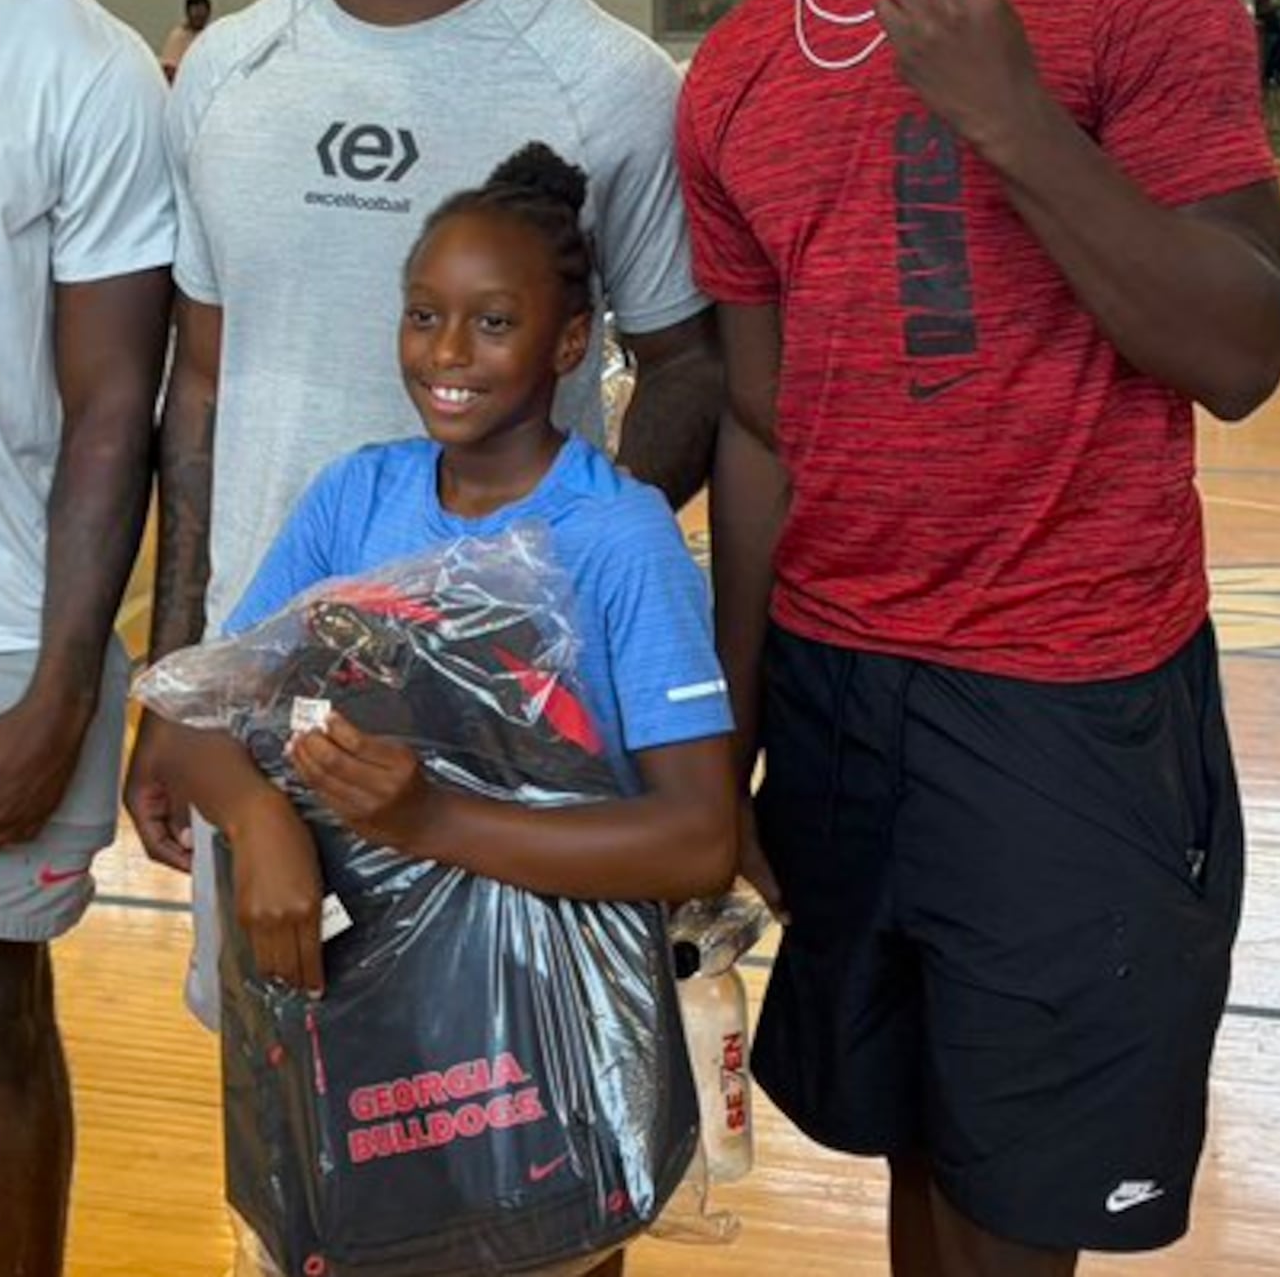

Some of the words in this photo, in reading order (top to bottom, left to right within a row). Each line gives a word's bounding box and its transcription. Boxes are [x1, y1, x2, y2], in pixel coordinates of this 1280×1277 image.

[895, 113, 978, 358] DAWGS
[347, 1051, 526, 1121] GEORGIA
[347, 1087, 544, 1164] BULLDOGS
